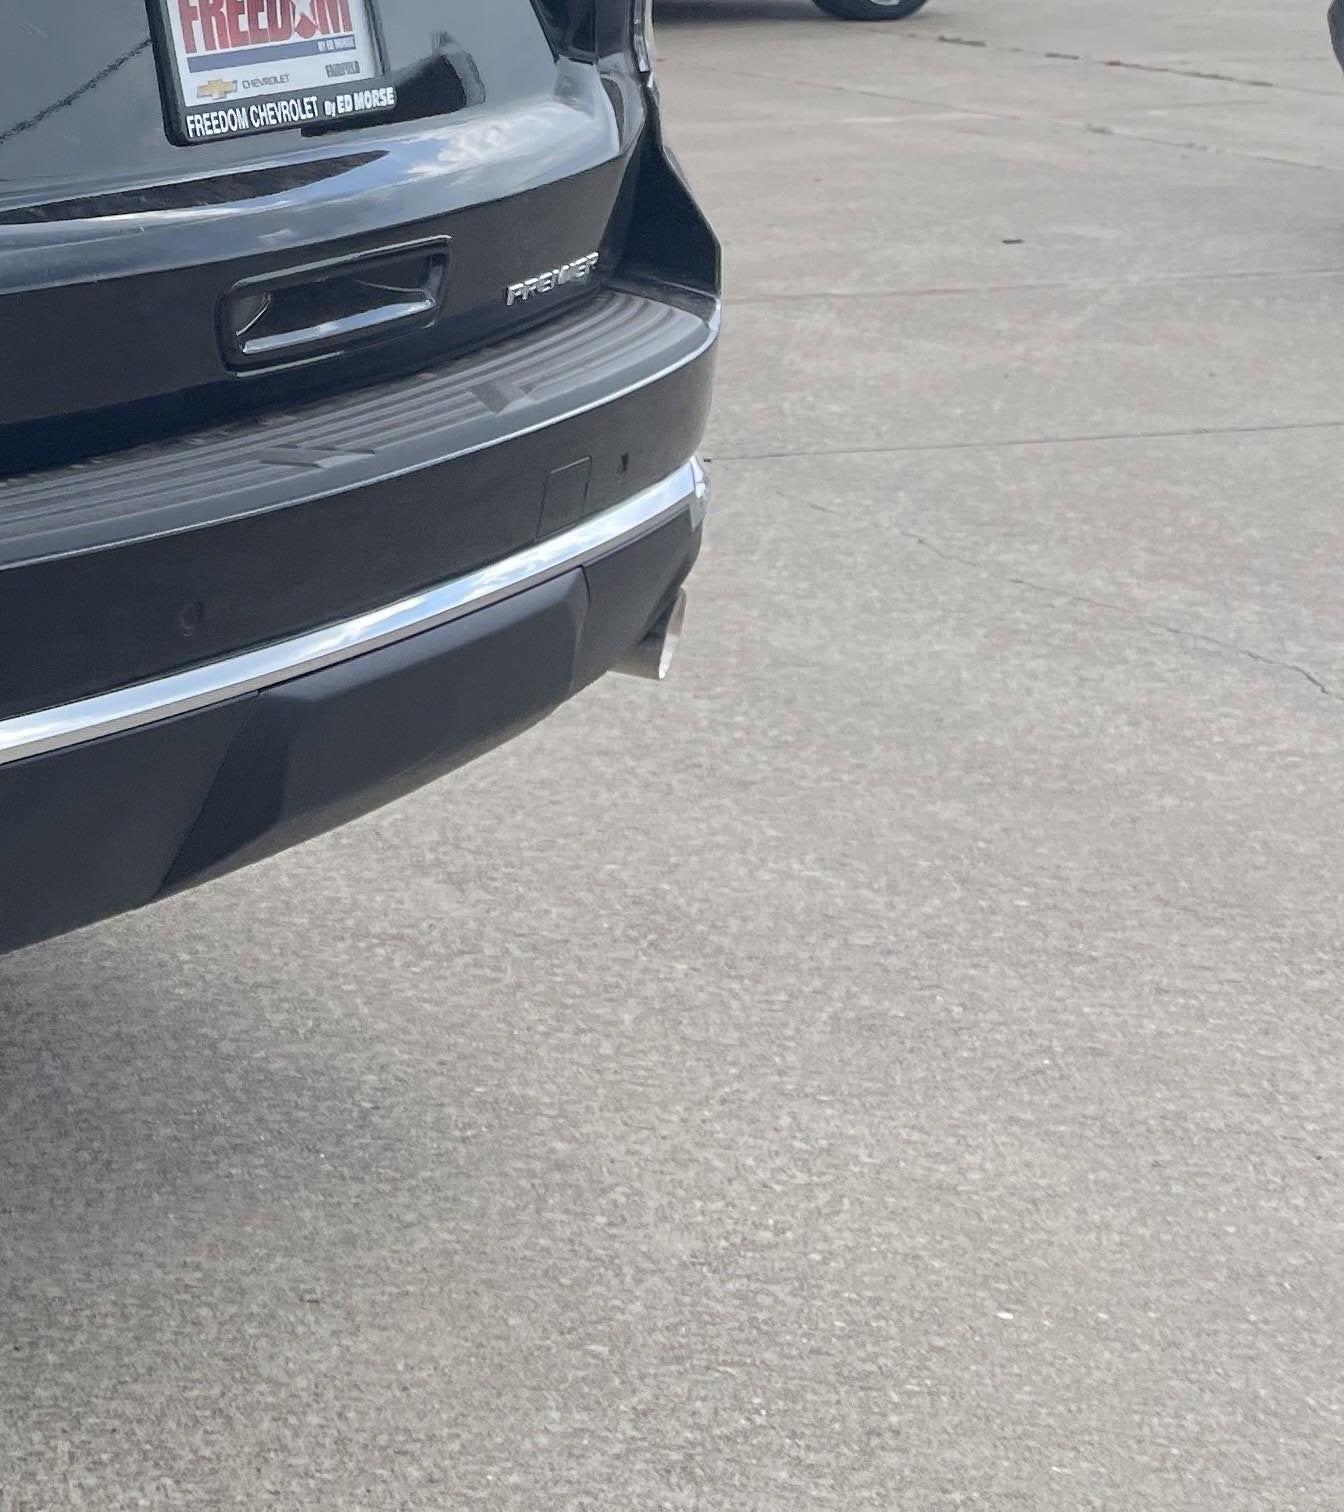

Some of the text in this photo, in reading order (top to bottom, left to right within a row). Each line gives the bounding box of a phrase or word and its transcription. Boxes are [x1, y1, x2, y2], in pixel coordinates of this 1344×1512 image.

[242, 74, 290, 89] CHEVROLET
[186, 106, 250, 138] FREEDOM
[249, 96, 319, 129] CHEVROLET
[336, 95, 354, 114] ED
[353, 87, 395, 111] MORSE
[506, 252, 599, 306] PREMIER
